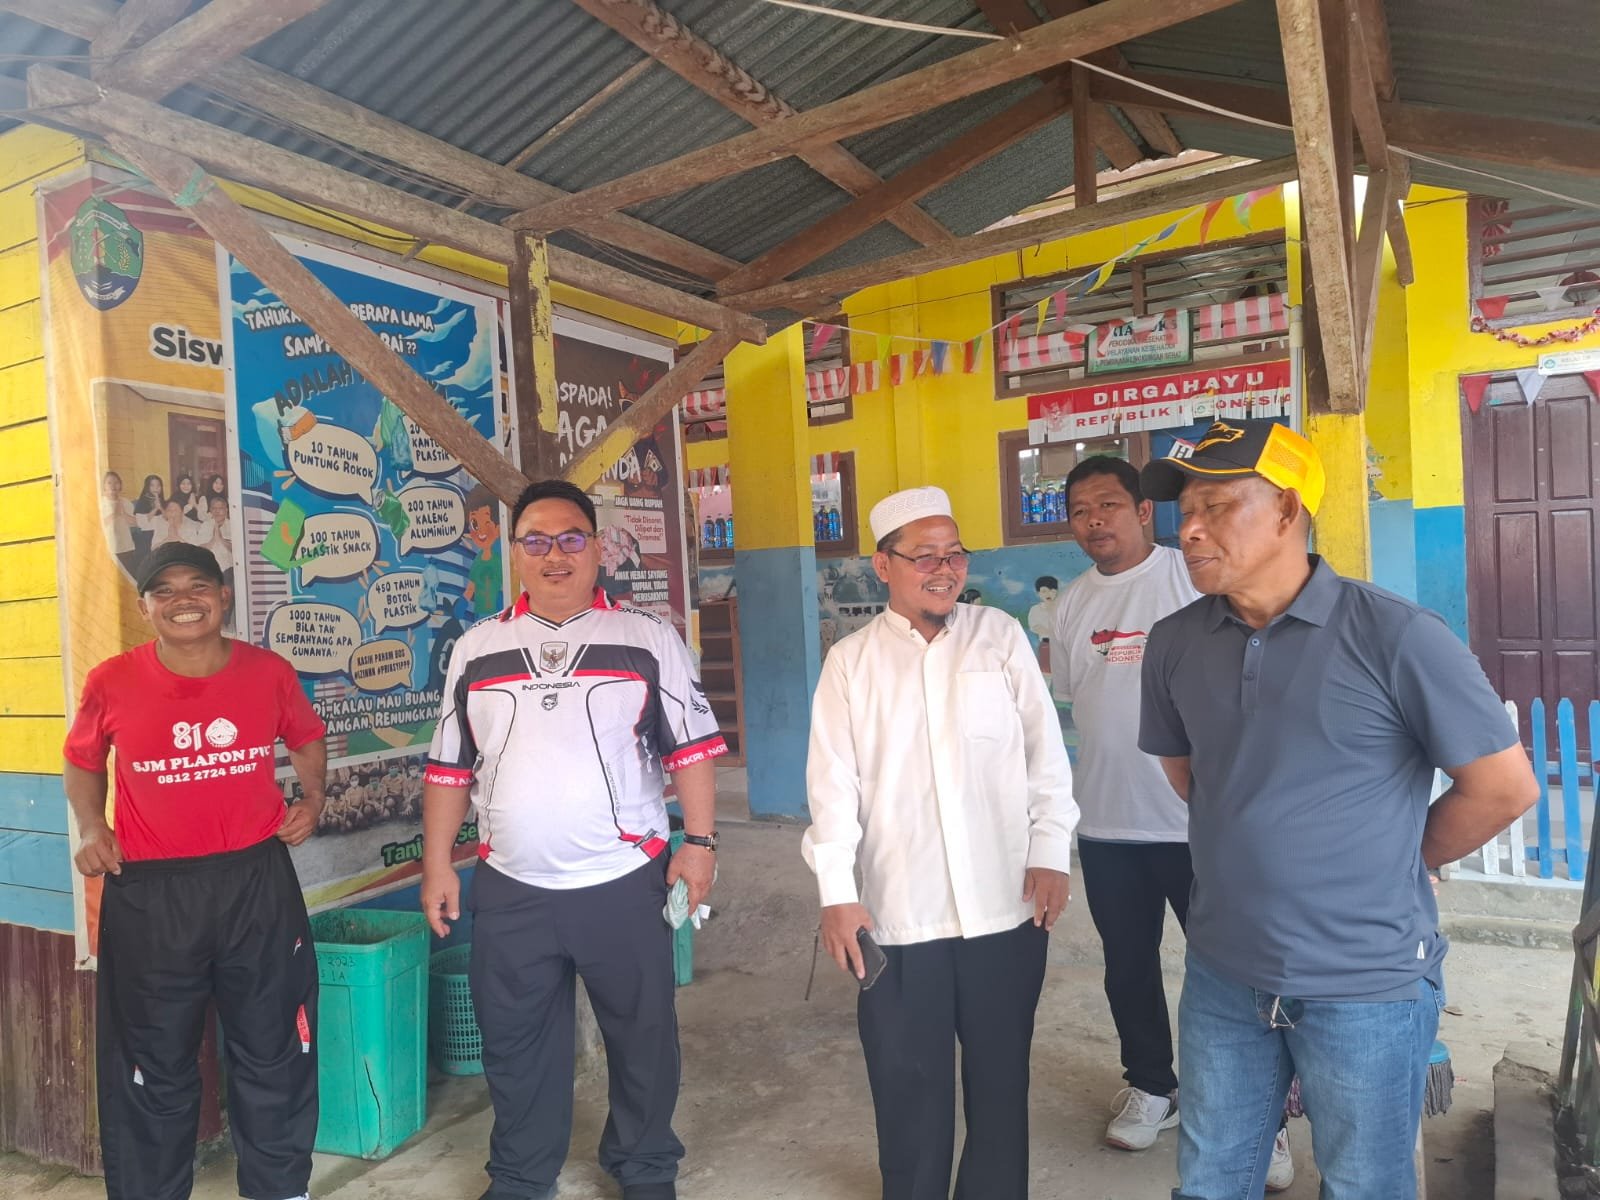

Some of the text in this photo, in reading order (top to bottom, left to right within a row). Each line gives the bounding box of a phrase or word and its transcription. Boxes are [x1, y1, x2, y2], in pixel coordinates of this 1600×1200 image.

[401, 312, 434, 332] LAMA
[406, 340, 417, 355] ??
[274, 361, 354, 416] ADALAH
[1093, 370, 1265, 405] DIRGAHAYU
[1075, 406, 1170, 428] REPUBLIK
[310, 441, 359, 463] 10 TAHUN
[293, 450, 374, 479] PUNTUNG ROKOK
[407, 499, 454, 513] 200 TAHUN
[415, 512, 449, 525] KALENG
[310, 529, 361, 544] 100 TAHUN
[342, 542, 372, 556] SNACK
[375, 577, 421, 594] 450 TAHUN
[386, 593, 413, 605] BOTOL
[288, 609, 342, 623] 1000 TAHUN
[318, 624, 336, 635] TAK
[275, 632, 353, 647] SEMBAHYANG APA
[521, 681, 581, 691] INDONESIA
[333, 698, 373, 716] KALAU
[376, 694, 402, 710] MAU
[172, 721, 203, 752] 81
[132, 758, 167, 773] SJM
[169, 747, 245, 771] PLAFON
[677, 751, 705, 768] NKRI
[157, 762, 258, 785] 0812 2724 5067
[429, 773, 456, 785] NKRI
